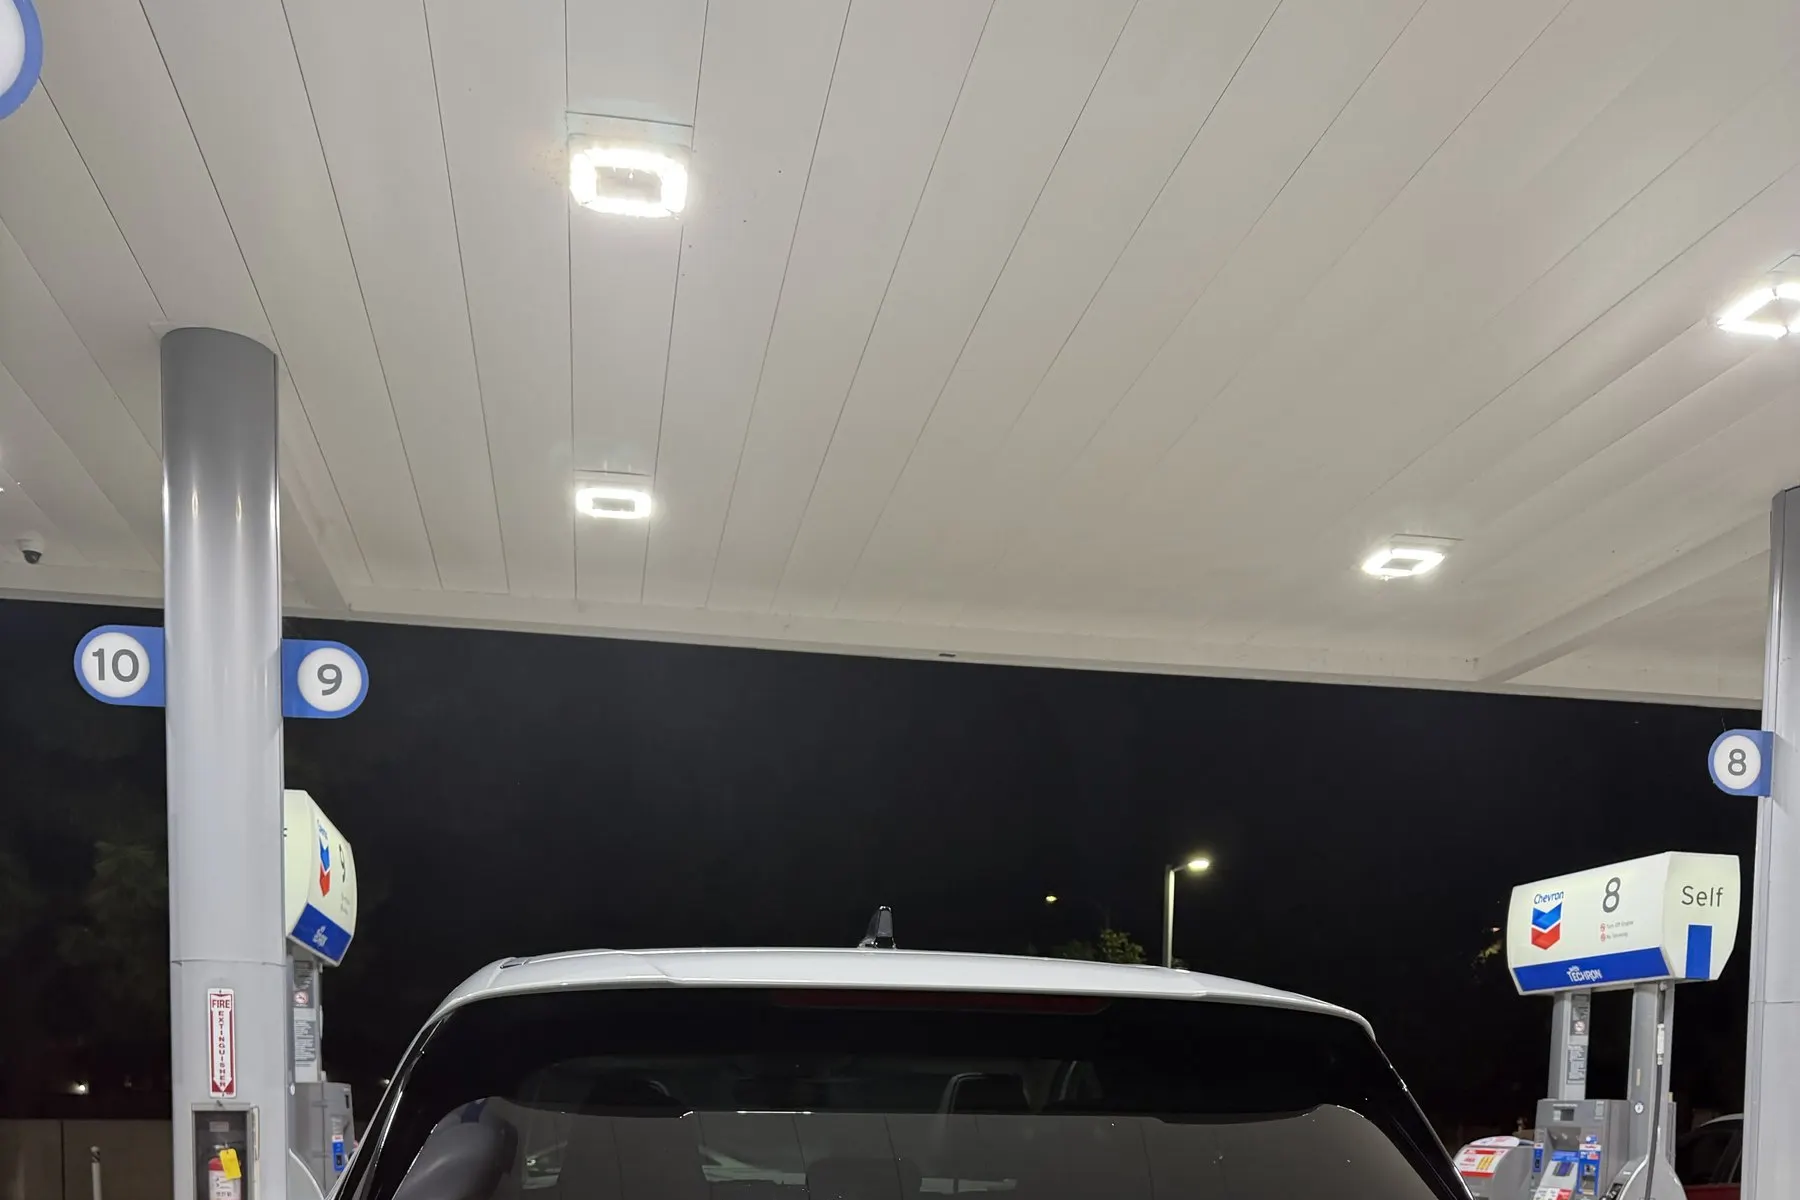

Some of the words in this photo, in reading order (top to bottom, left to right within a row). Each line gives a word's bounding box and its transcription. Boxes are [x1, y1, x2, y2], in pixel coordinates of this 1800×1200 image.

[92, 648, 140, 682] 10
[317, 663, 342, 696] 9
[1727, 748, 1747, 776] 8
[1533, 891, 1564, 905] Chevron
[1602, 876, 1621, 913] 8
[1681, 885, 1723, 908] Self
[212, 1000, 231, 1009] FIRE
[218, 1010, 226, 1087] EXTINGUISHER
